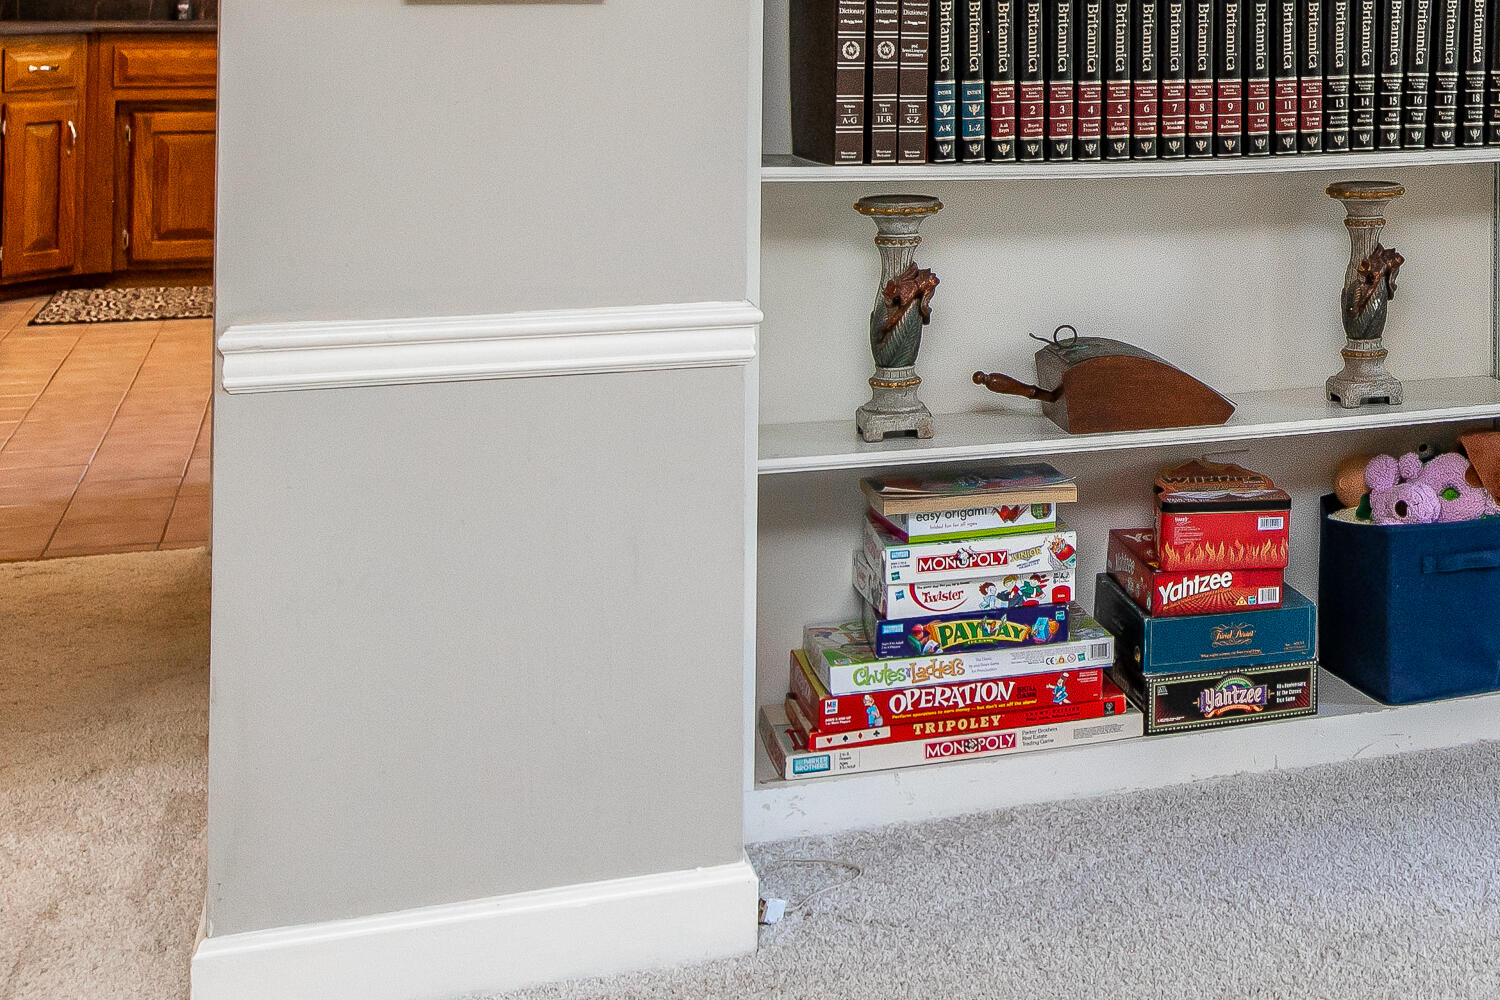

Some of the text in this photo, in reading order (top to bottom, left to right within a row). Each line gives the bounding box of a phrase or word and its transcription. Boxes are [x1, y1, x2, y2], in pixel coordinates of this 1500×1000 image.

[940, 1, 952, 73] Britannica
[998, 1, 1010, 73] Britannica
[1028, 2, 1040, 73] Britannica
[1198, 3, 1209, 72] Britannica
[1256, 3, 1267, 70] Britannica
[1416, 0, 1429, 65] Britannica
[1001, 106, 1006, 114] 1
[1030, 106, 1036, 114] 2
[1117, 104, 1123, 113] 5
[1199, 103, 1205, 112] 8
[1256, 102, 1265, 111] 10
[1335, 99, 1344, 108] 13
[1414, 96, 1423, 104] 16
[916, 508, 987, 523] easy origami
[918, 551, 1007, 572] MONOPOLY
[922, 589, 964, 604] Twister
[1159, 571, 1233, 605] Yahtzee
[852, 663, 906, 686] Chutes
[909, 658, 966, 683] Ladders
[889, 681, 1016, 714] OPERATION
[1204, 685, 1262, 712] Yahtzee
[912, 714, 1002, 735] TRIPOLEY
[925, 734, 1016, 759] MONOPOLY
